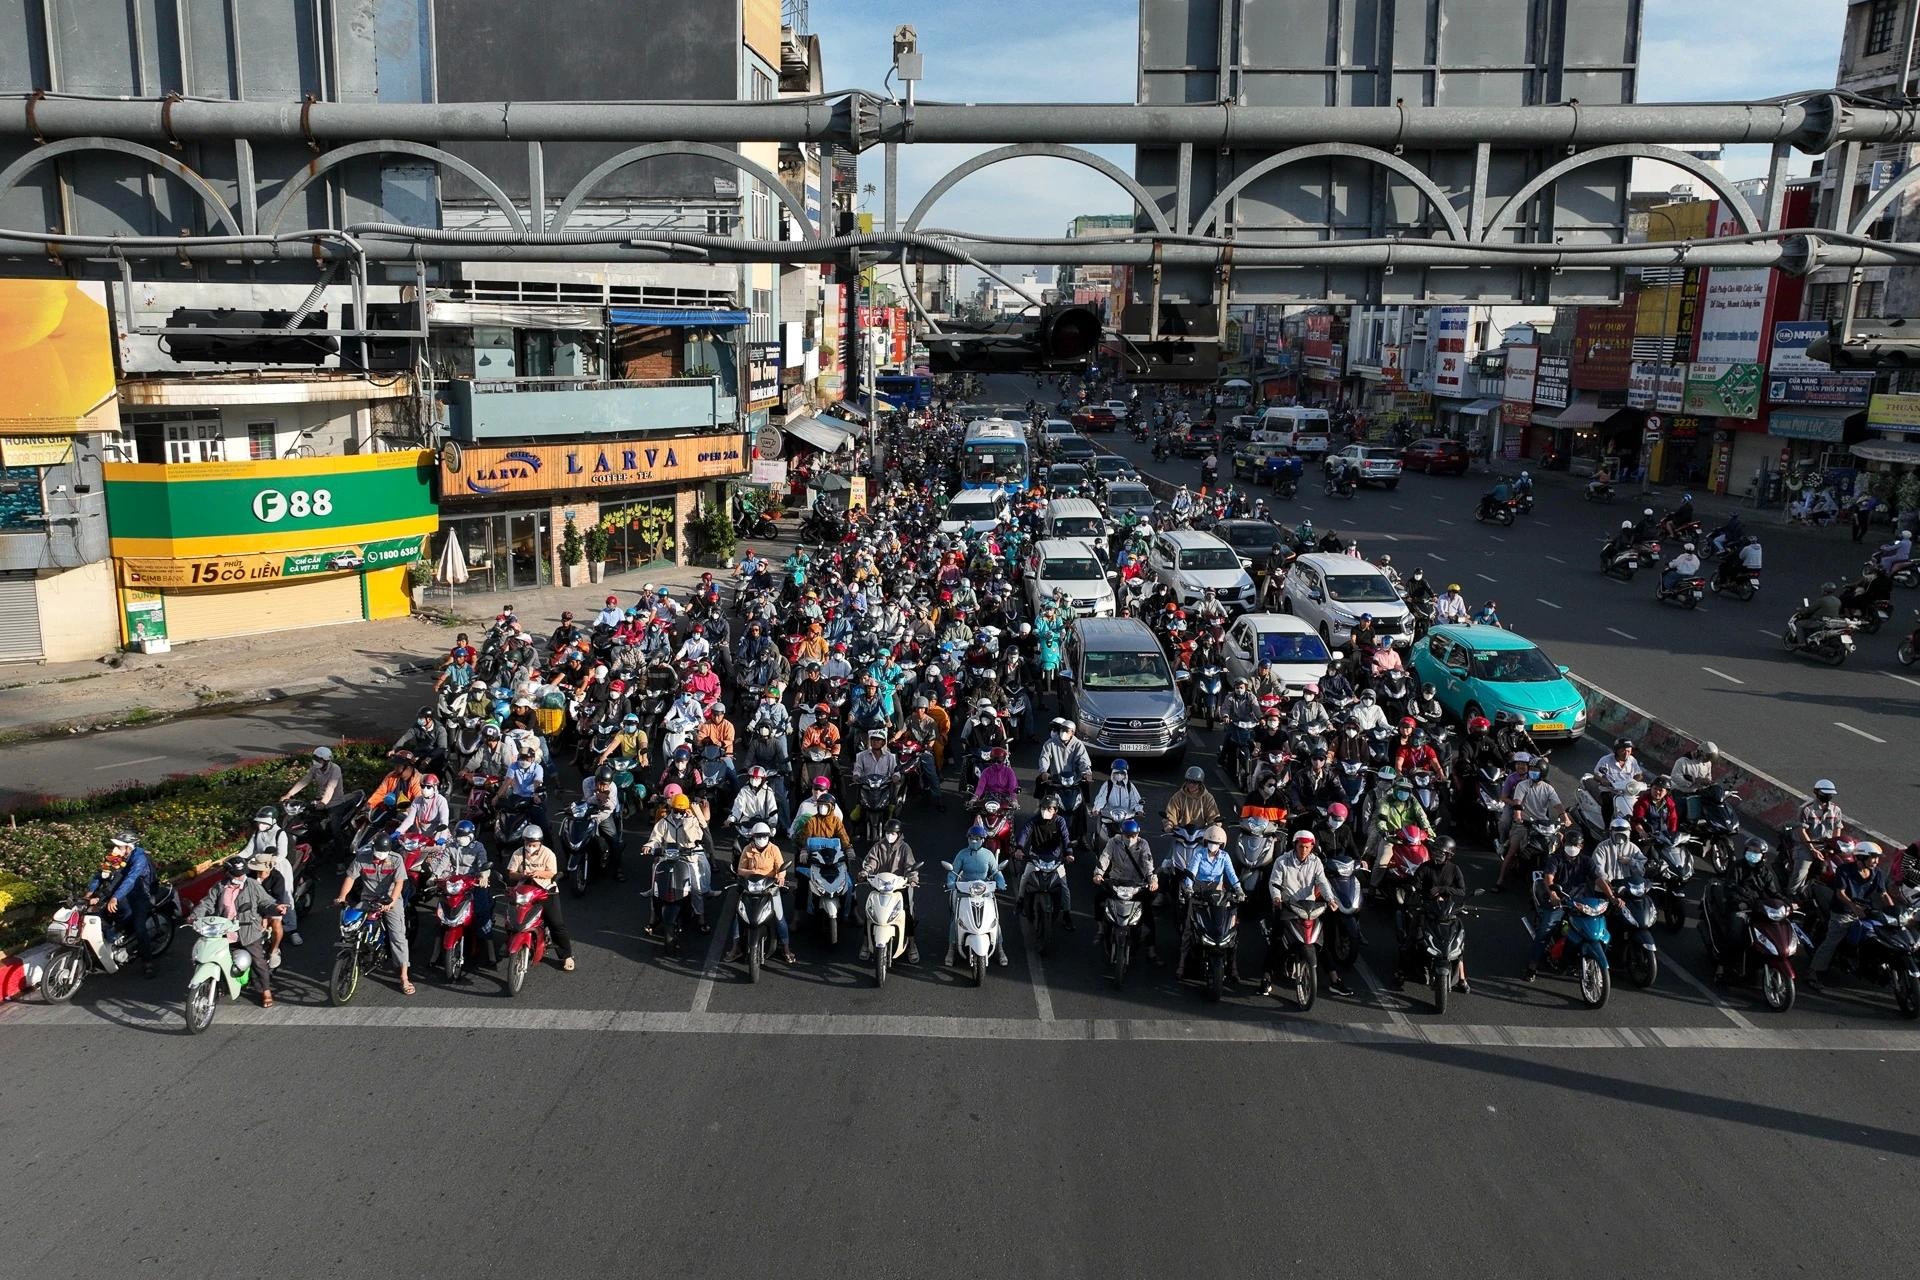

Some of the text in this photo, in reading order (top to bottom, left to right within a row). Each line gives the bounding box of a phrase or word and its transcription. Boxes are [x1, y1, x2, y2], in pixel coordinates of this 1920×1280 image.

[1605, 323, 1627, 331] QUAY
[1788, 376, 1801, 384] CỬA
[1802, 376, 1818, 384] HÀNG
[1805, 384, 1820, 392] PHÂN
[566, 447, 679, 475] LARVA
[697, 451, 721, 463] OPEN
[477, 468, 529, 481] LARVA
[591, 471, 655, 483] COFFEE TEA
[379, 549, 399, 560] 1800
[224, 558, 243, 568] PHÚT
[191, 562, 220, 584] 15
[221, 561, 281, 581] CÓ LIỀN
